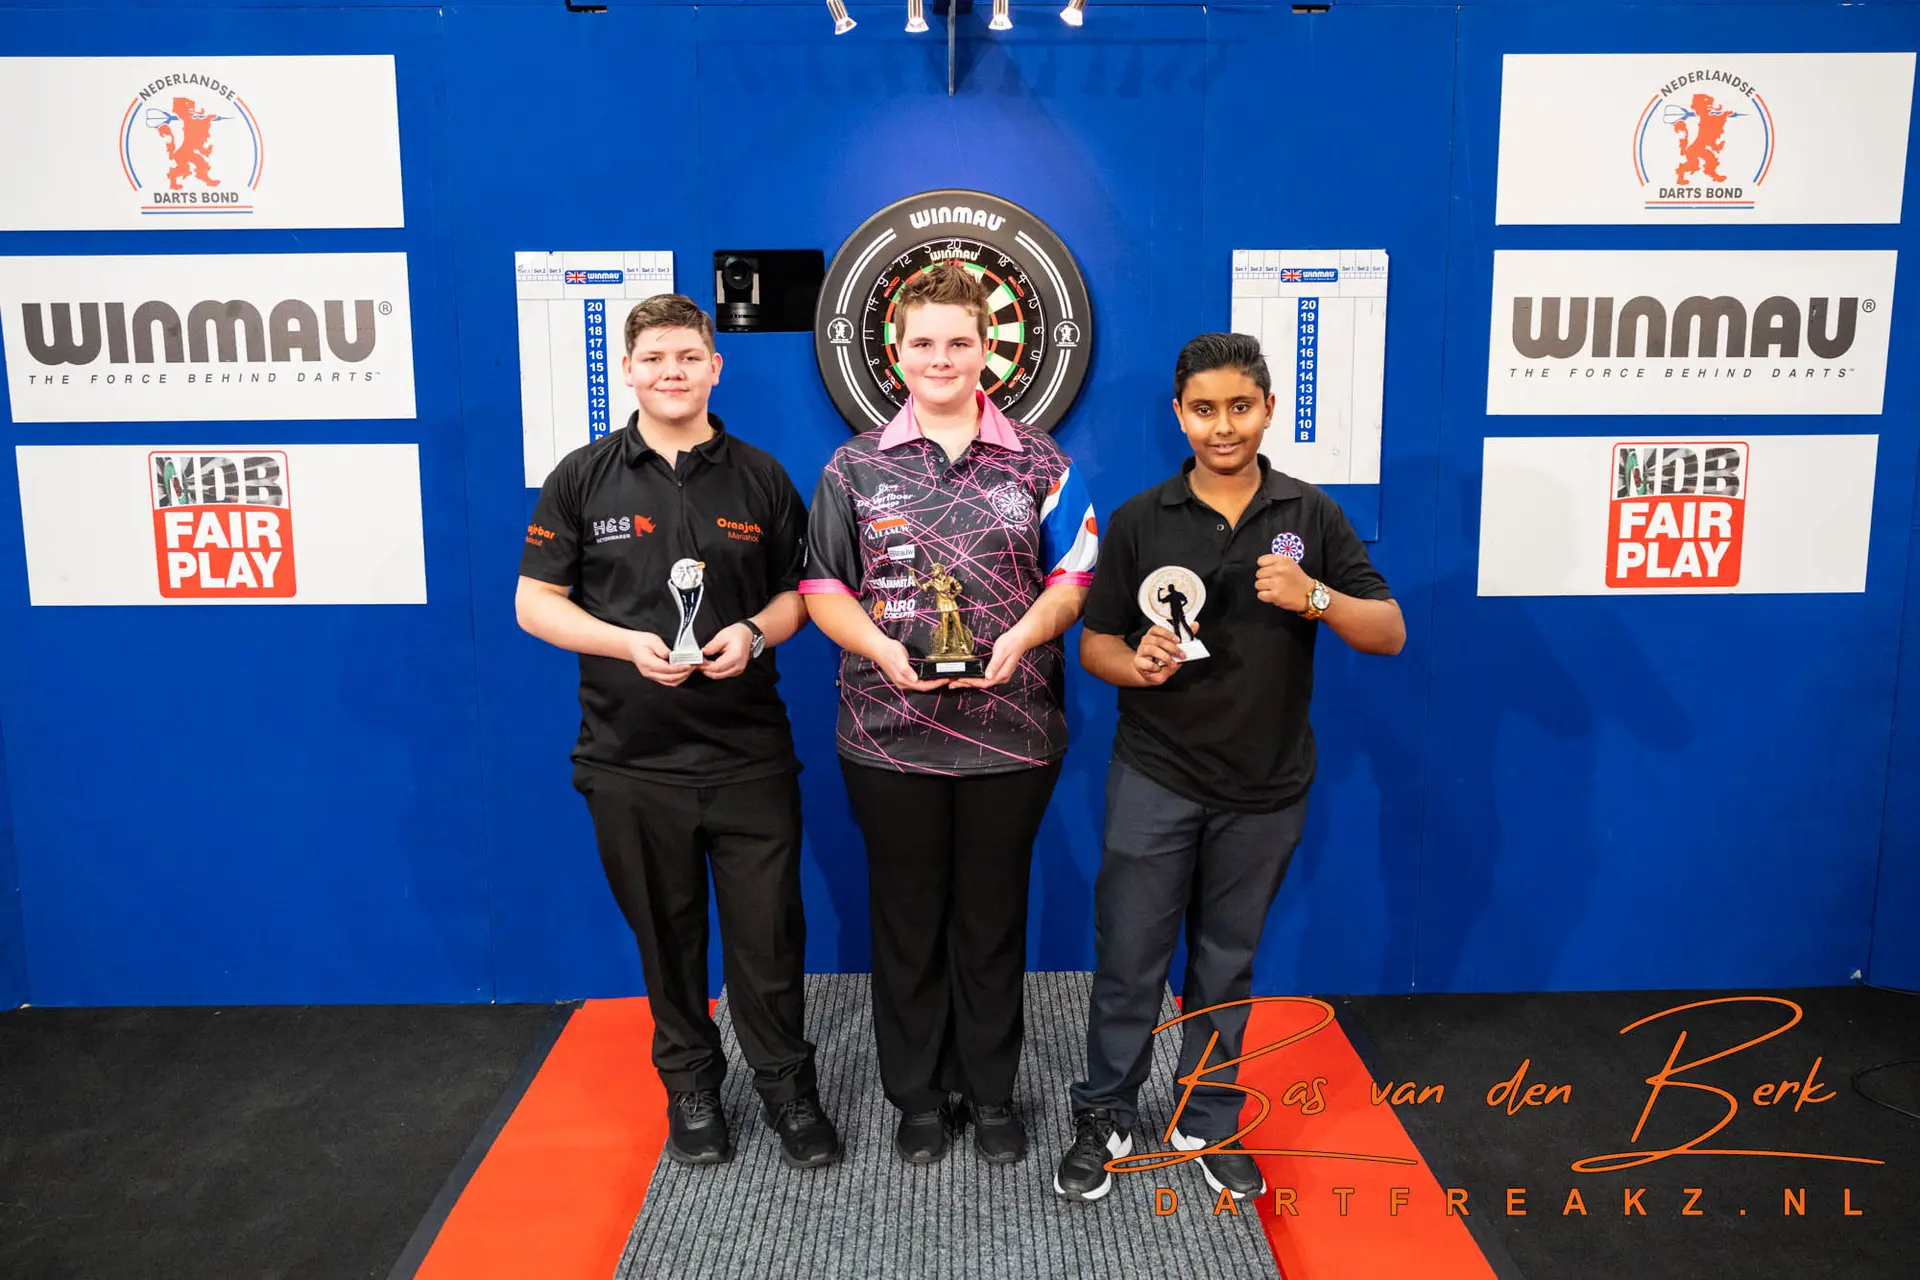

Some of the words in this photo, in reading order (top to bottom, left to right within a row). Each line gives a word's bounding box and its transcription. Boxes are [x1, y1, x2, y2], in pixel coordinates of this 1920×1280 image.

[138, 72, 236, 102] NEDERLANDSE
[1660, 69, 1756, 98] NEDERLANDSE
[153, 191, 198, 204] DARTS
[201, 191, 239, 204] BOND
[1659, 187, 1701, 199] DARTS
[1706, 187, 1743, 199] BOND
[909, 206, 1003, 231] WINMAU
[947, 238, 961, 250] 20
[930, 249, 978, 261] WINMAU
[587, 272, 620, 280] WINMAU
[1303, 270, 1336, 278] WINMAU
[588, 302, 602, 311] 20
[1301, 300, 1316, 310] 20
[588, 314, 602, 324] 19
[1301, 312, 1314, 322] 19
[588, 326, 602, 336] 18
[1300, 324, 1314, 334] 18
[589, 338, 602, 348] 17
[1300, 336, 1314, 346] 17
[589, 350, 603, 360] 16
[1300, 348, 1314, 358] 16
[590, 362, 604, 372] 15
[1300, 360, 1314, 369] 15
[1300, 372, 1313, 381] 14
[1509, 368, 1550, 379] THE
[1570, 368, 1646, 379] FORCE
[1664, 367, 1753, 379] BEHIND
[28, 374, 70, 386] THE
[90, 373, 168, 385] FORCE
[187, 372, 277, 384] BEHIND
[590, 374, 604, 384] 14
[591, 386, 605, 396] 13
[1299, 384, 1312, 393] 13
[591, 398, 606, 408] 12
[1299, 396, 1312, 405] 12
[592, 410, 604, 420] 11
[1298, 408, 1311, 416] 11
[592, 422, 606, 432] 10
[1298, 420, 1312, 428] 10
[1300, 432, 1309, 440] B
[1617, 447, 1741, 499] NDB
[155, 456, 283, 508] NDB
[1618, 501, 1733, 539] FAIR
[164, 511, 283, 549] FAIR
[593, 516, 631, 536] H&S
[1616, 541, 1731, 579] PLAY
[167, 551, 283, 589] PLAY
